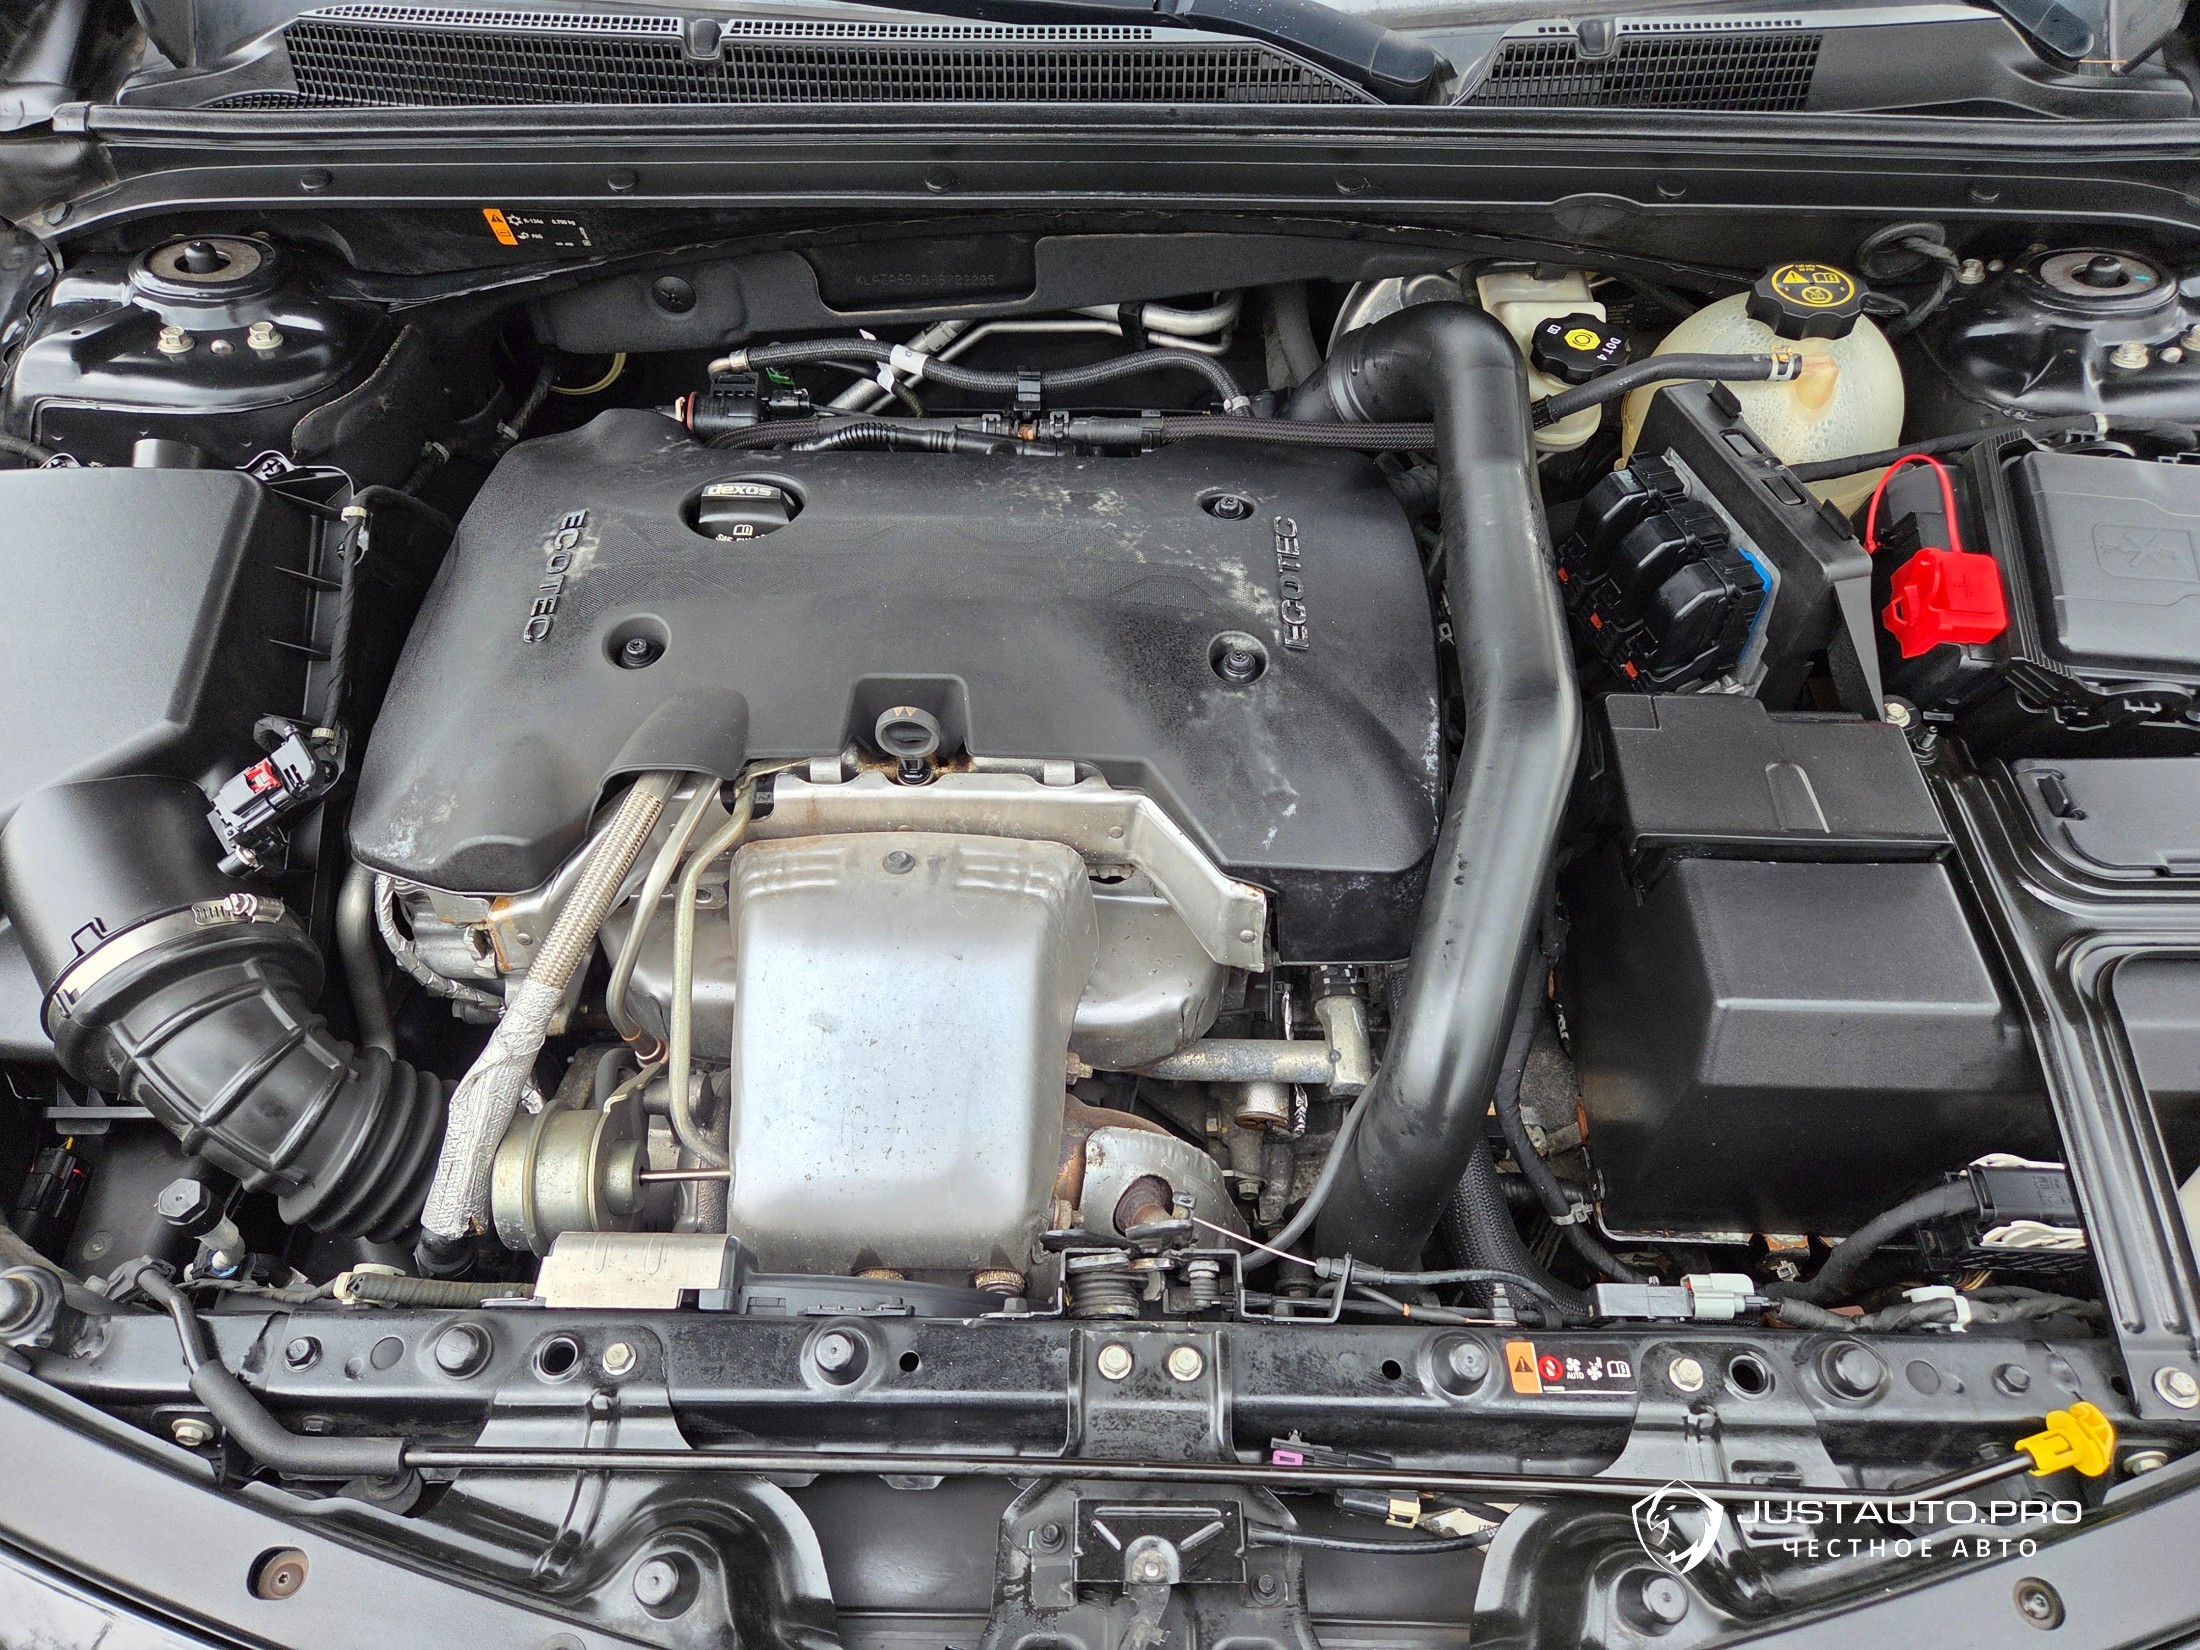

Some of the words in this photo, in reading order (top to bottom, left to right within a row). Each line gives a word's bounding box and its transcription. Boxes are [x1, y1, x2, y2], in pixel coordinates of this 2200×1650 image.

[1602, 337, 1621, 355] DOT
[707, 484, 773, 496] dexos
[523, 509, 588, 643] ECOTEC
[1273, 515, 1309, 650] ECOTEC
